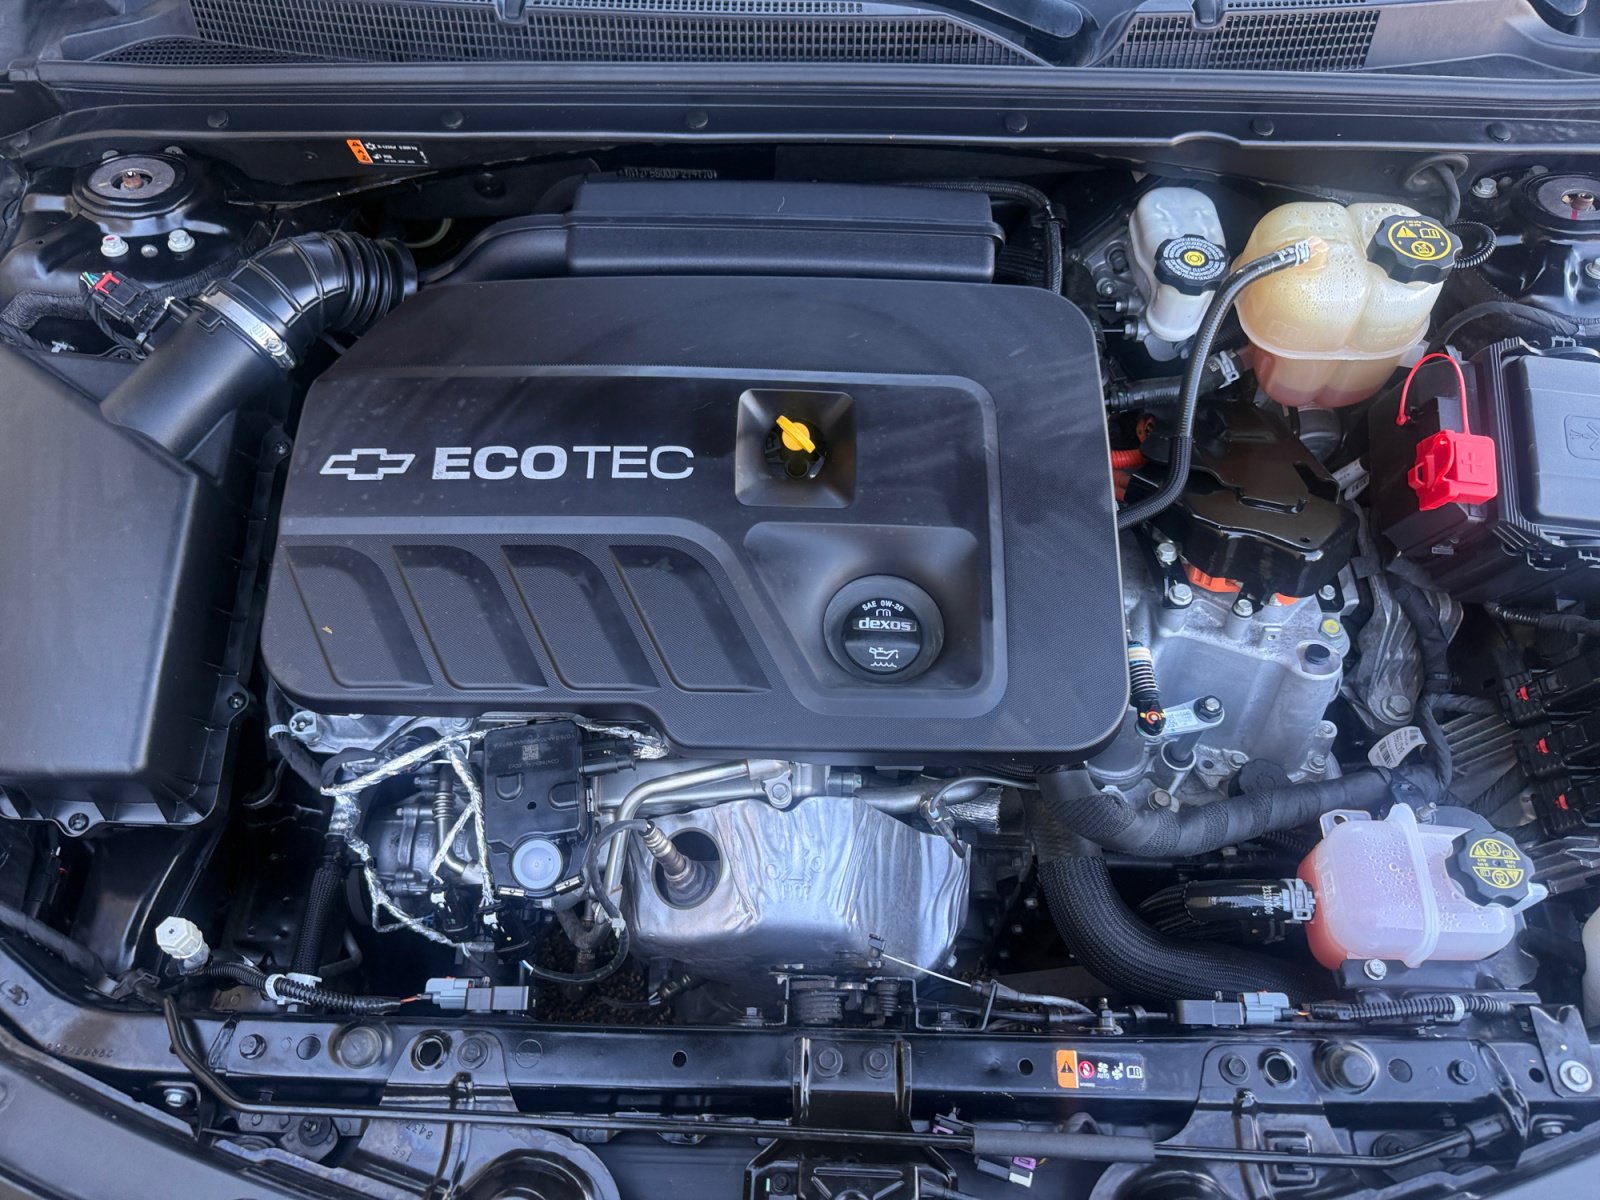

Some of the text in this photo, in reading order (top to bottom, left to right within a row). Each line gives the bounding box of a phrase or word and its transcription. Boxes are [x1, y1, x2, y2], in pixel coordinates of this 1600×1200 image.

[432, 445, 694, 481] ECOTEC
[862, 600, 905, 612] SAE 0W-20
[858, 617, 913, 631] dexos
